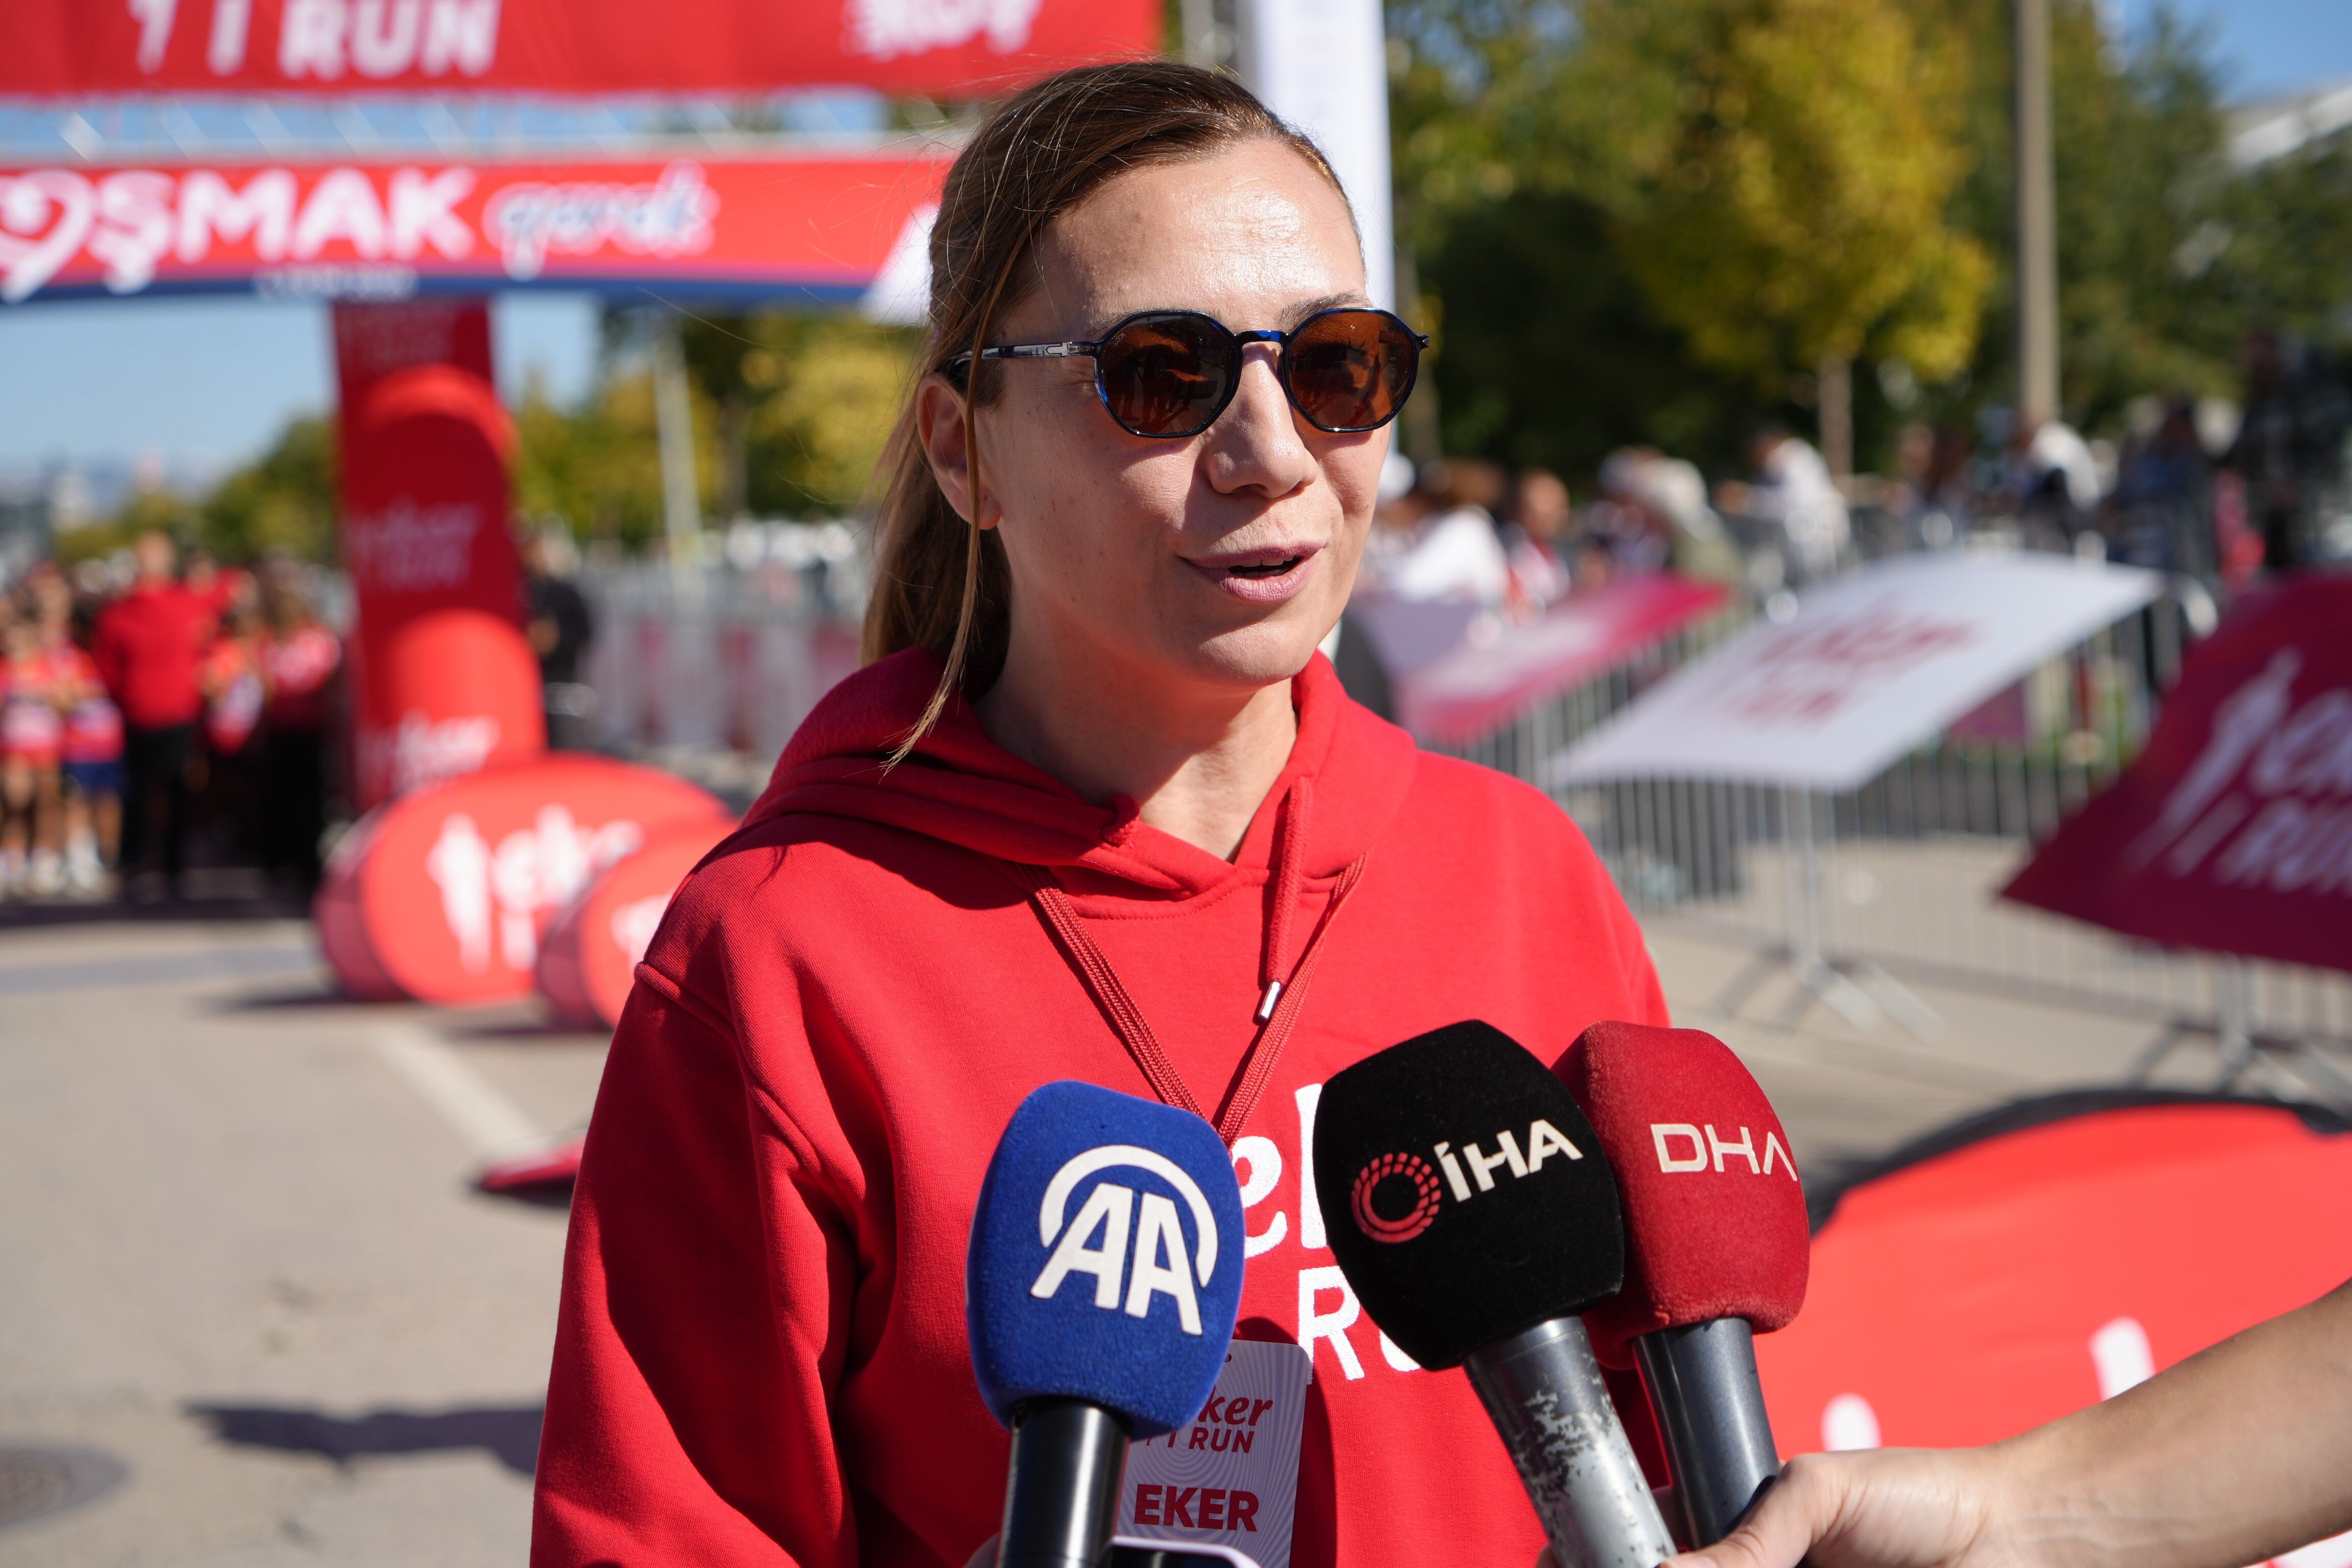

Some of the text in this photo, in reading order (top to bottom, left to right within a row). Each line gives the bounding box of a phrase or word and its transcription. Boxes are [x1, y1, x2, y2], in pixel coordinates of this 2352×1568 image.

[278, 0, 501, 80] RUN
[1434, 1119, 1583, 1202] İHA
[1651, 1123, 1797, 1181] DHA
[1030, 1183, 1203, 1336] AA
[1198, 1384, 1273, 1426] ker
[1189, 1427, 1255, 1454] RUN
[1134, 1484, 1259, 1532] EKER
